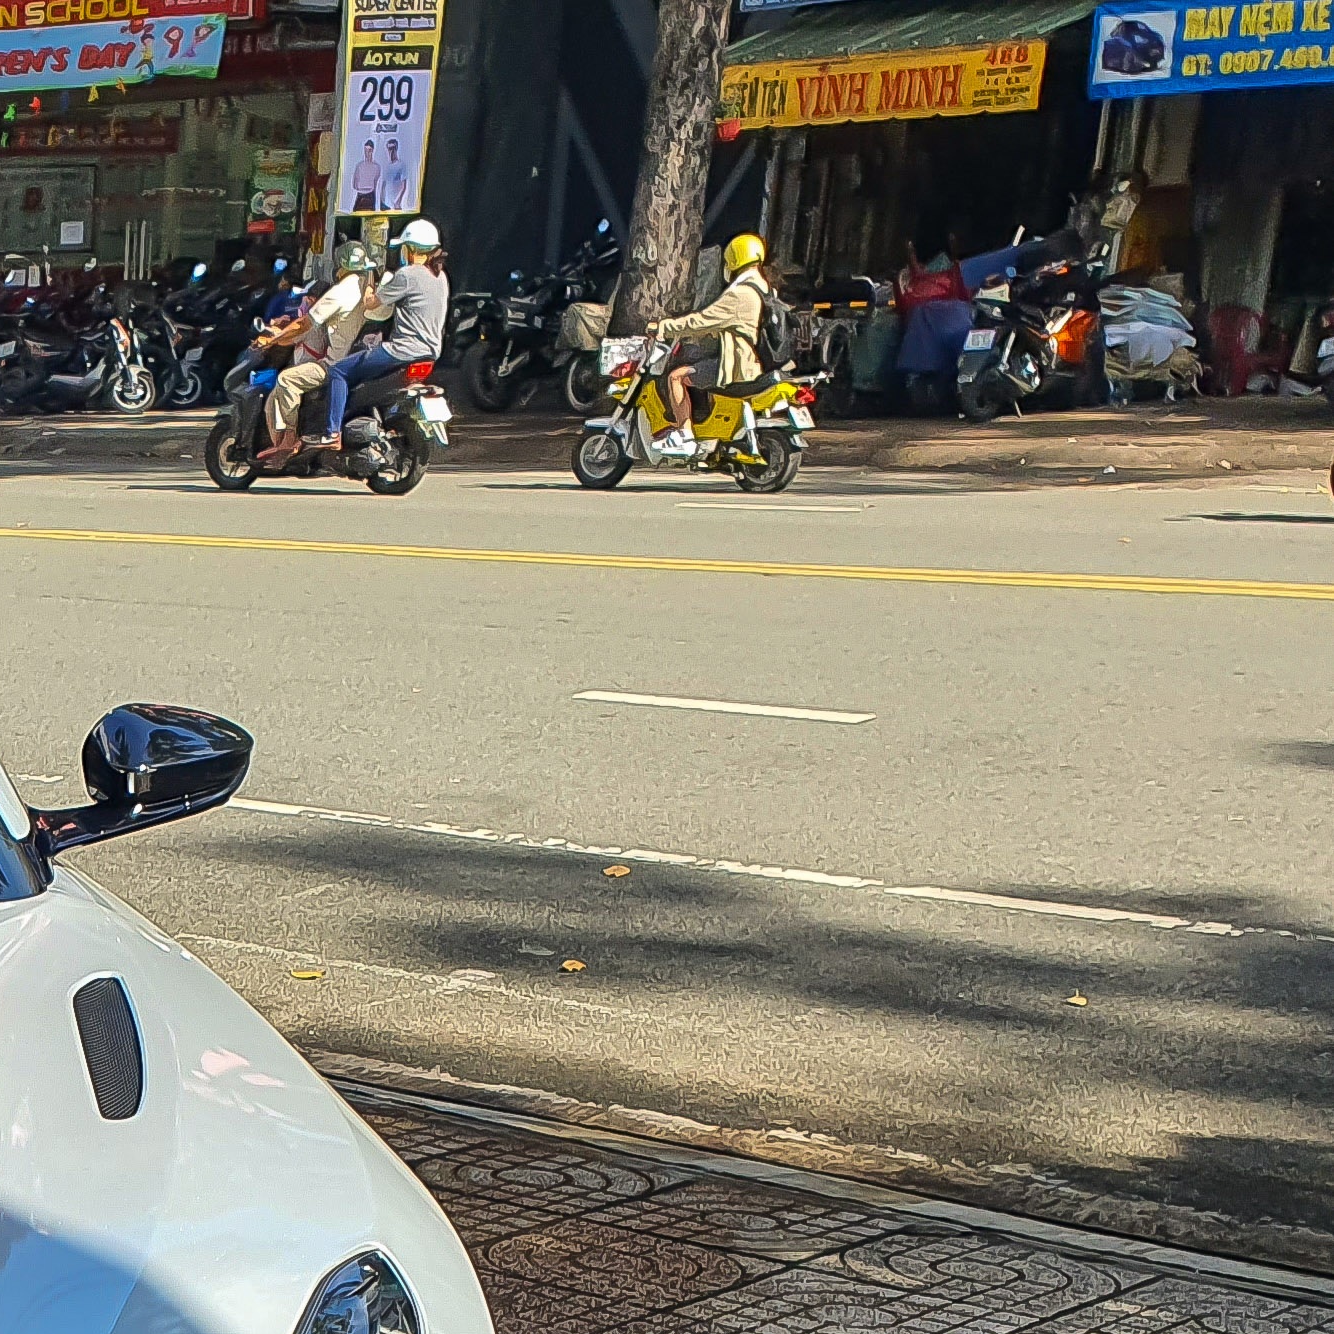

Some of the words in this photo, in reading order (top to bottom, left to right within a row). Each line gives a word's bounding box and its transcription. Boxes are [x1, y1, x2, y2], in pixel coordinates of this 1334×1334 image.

[24, 0, 150, 25] SCHOOL
[77, 42, 137, 70] DAY
[359, 75, 414, 122] 299
[875, 64, 966, 112] MINH
